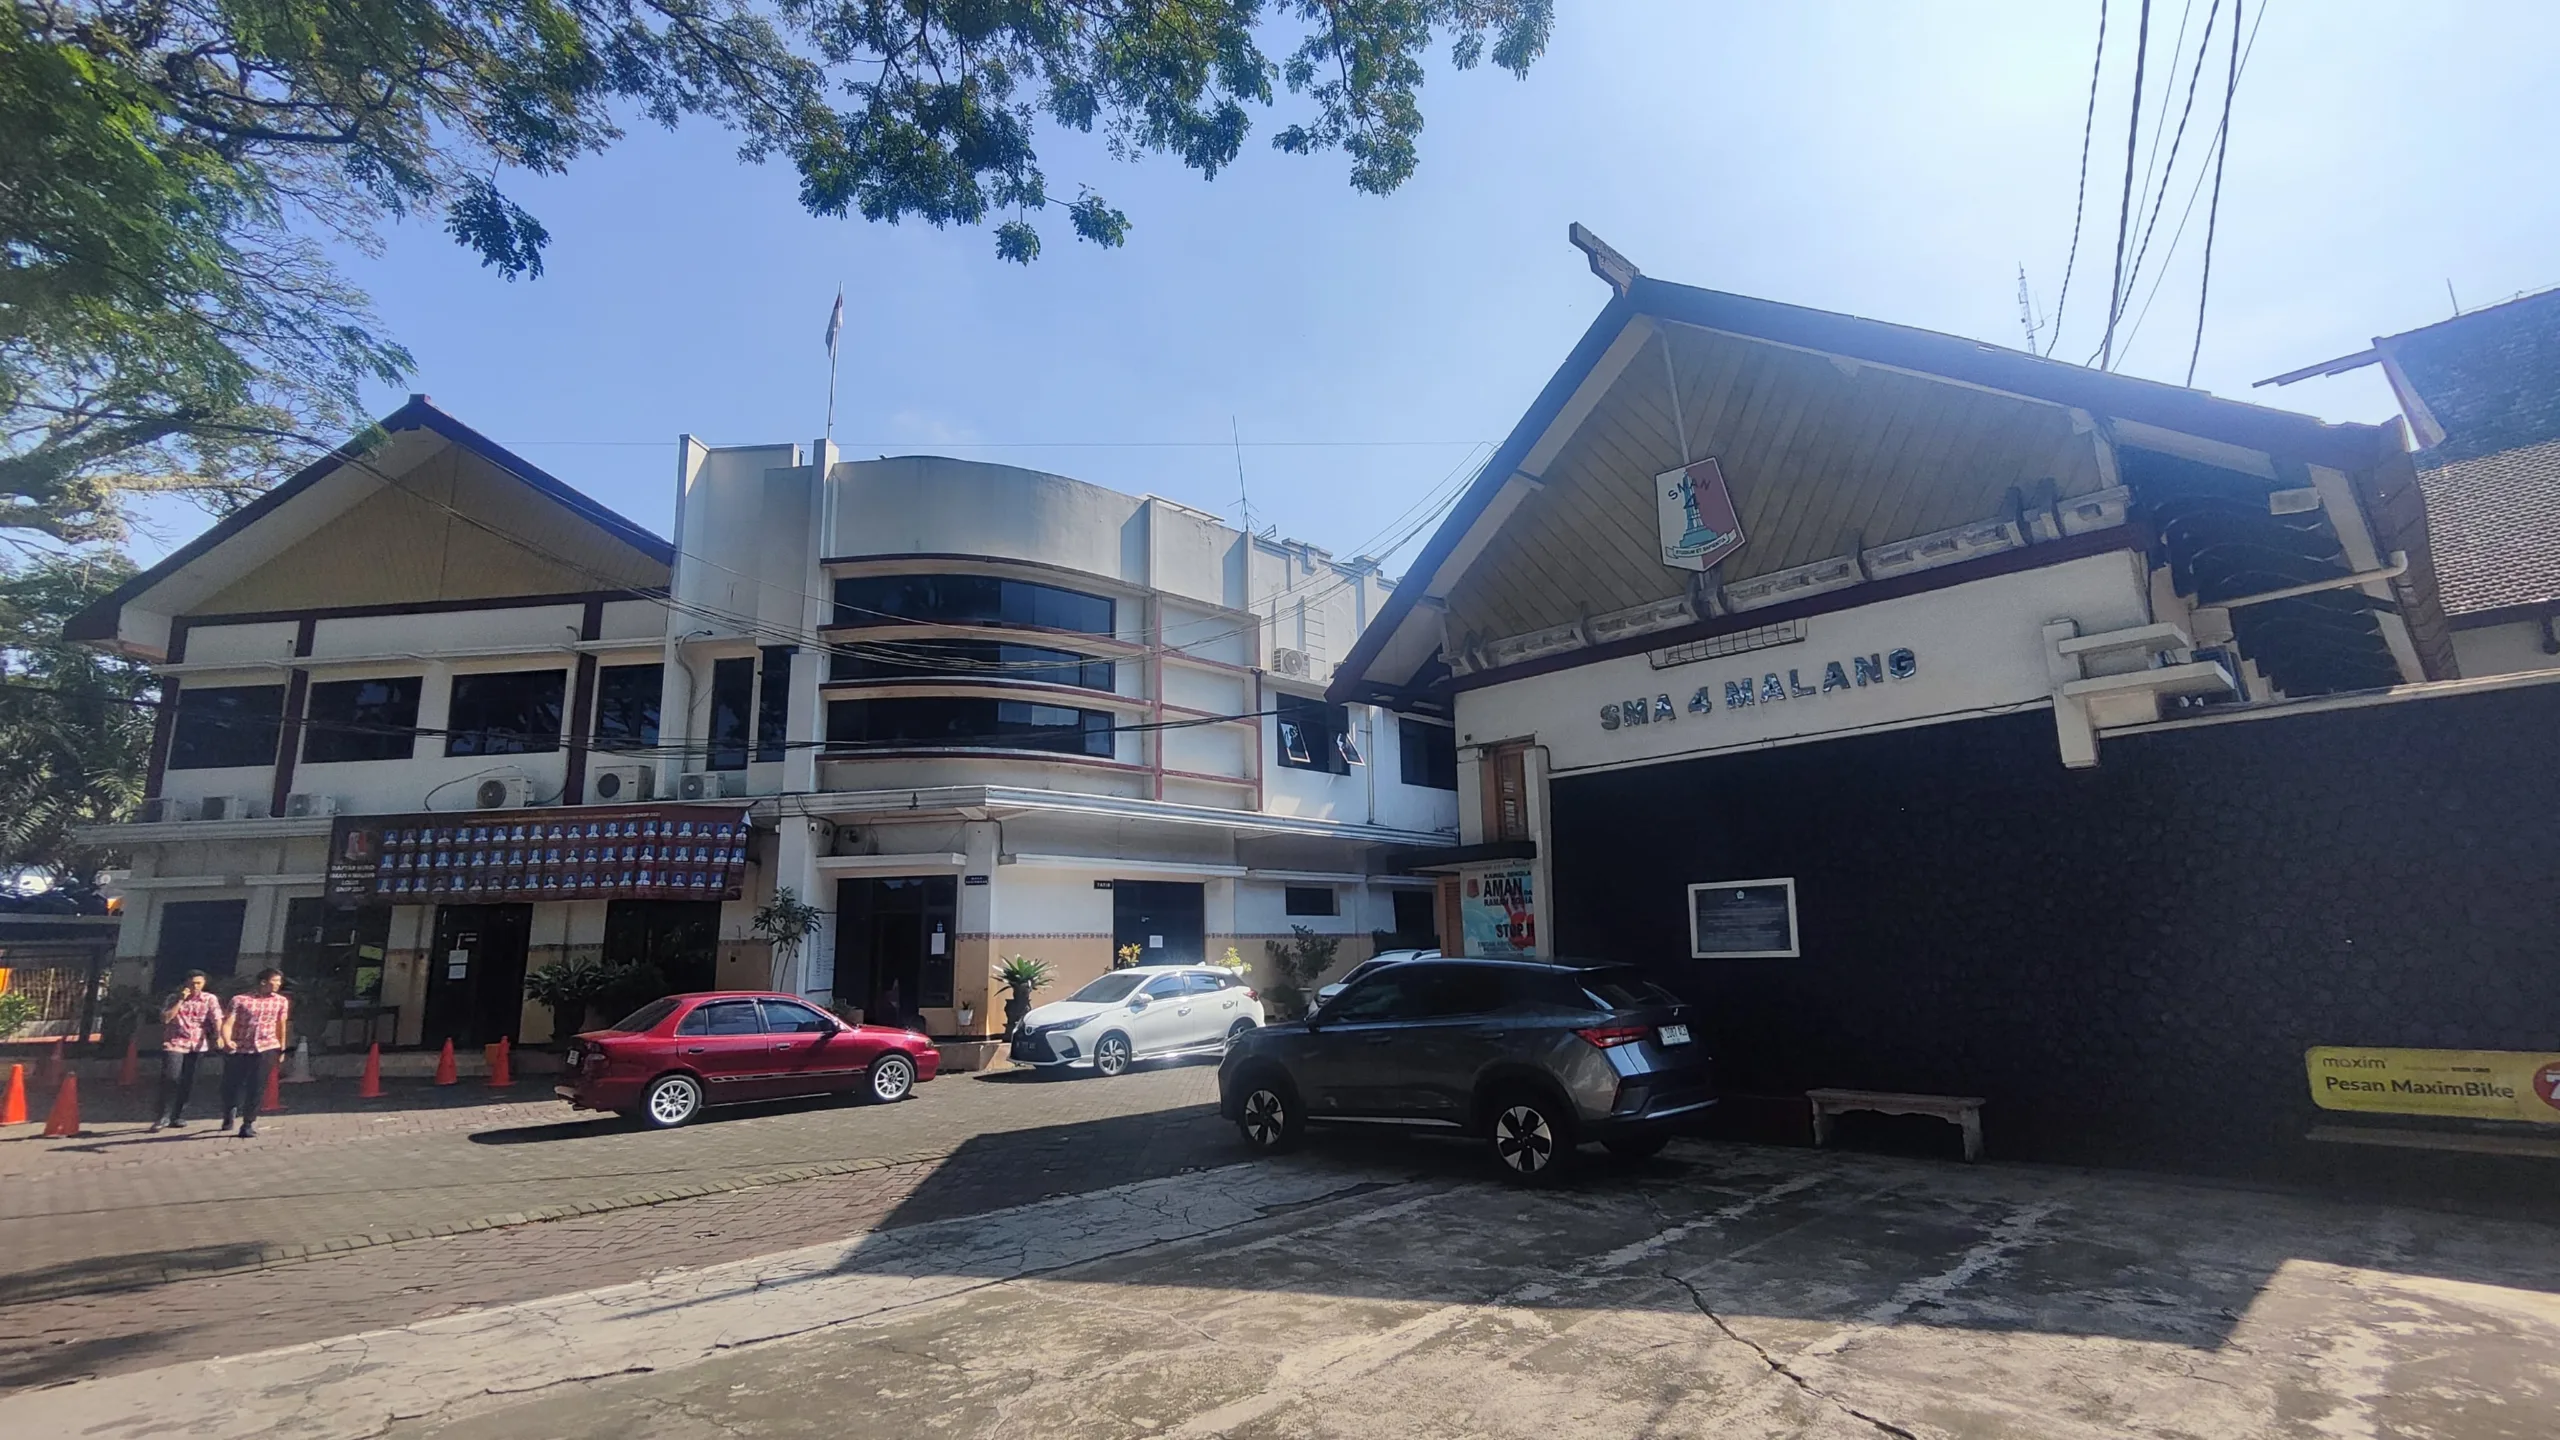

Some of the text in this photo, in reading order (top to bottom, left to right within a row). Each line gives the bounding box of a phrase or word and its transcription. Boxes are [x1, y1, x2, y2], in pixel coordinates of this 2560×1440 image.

[1600, 648, 1917, 730] SMA 4 MALANG
[1484, 877, 1522, 897] AMAN
[1496, 923, 1523, 938] STOP
[2322, 1056, 2387, 1070] maxim
[2325, 1075, 2515, 1099] Pesan MaximBike
